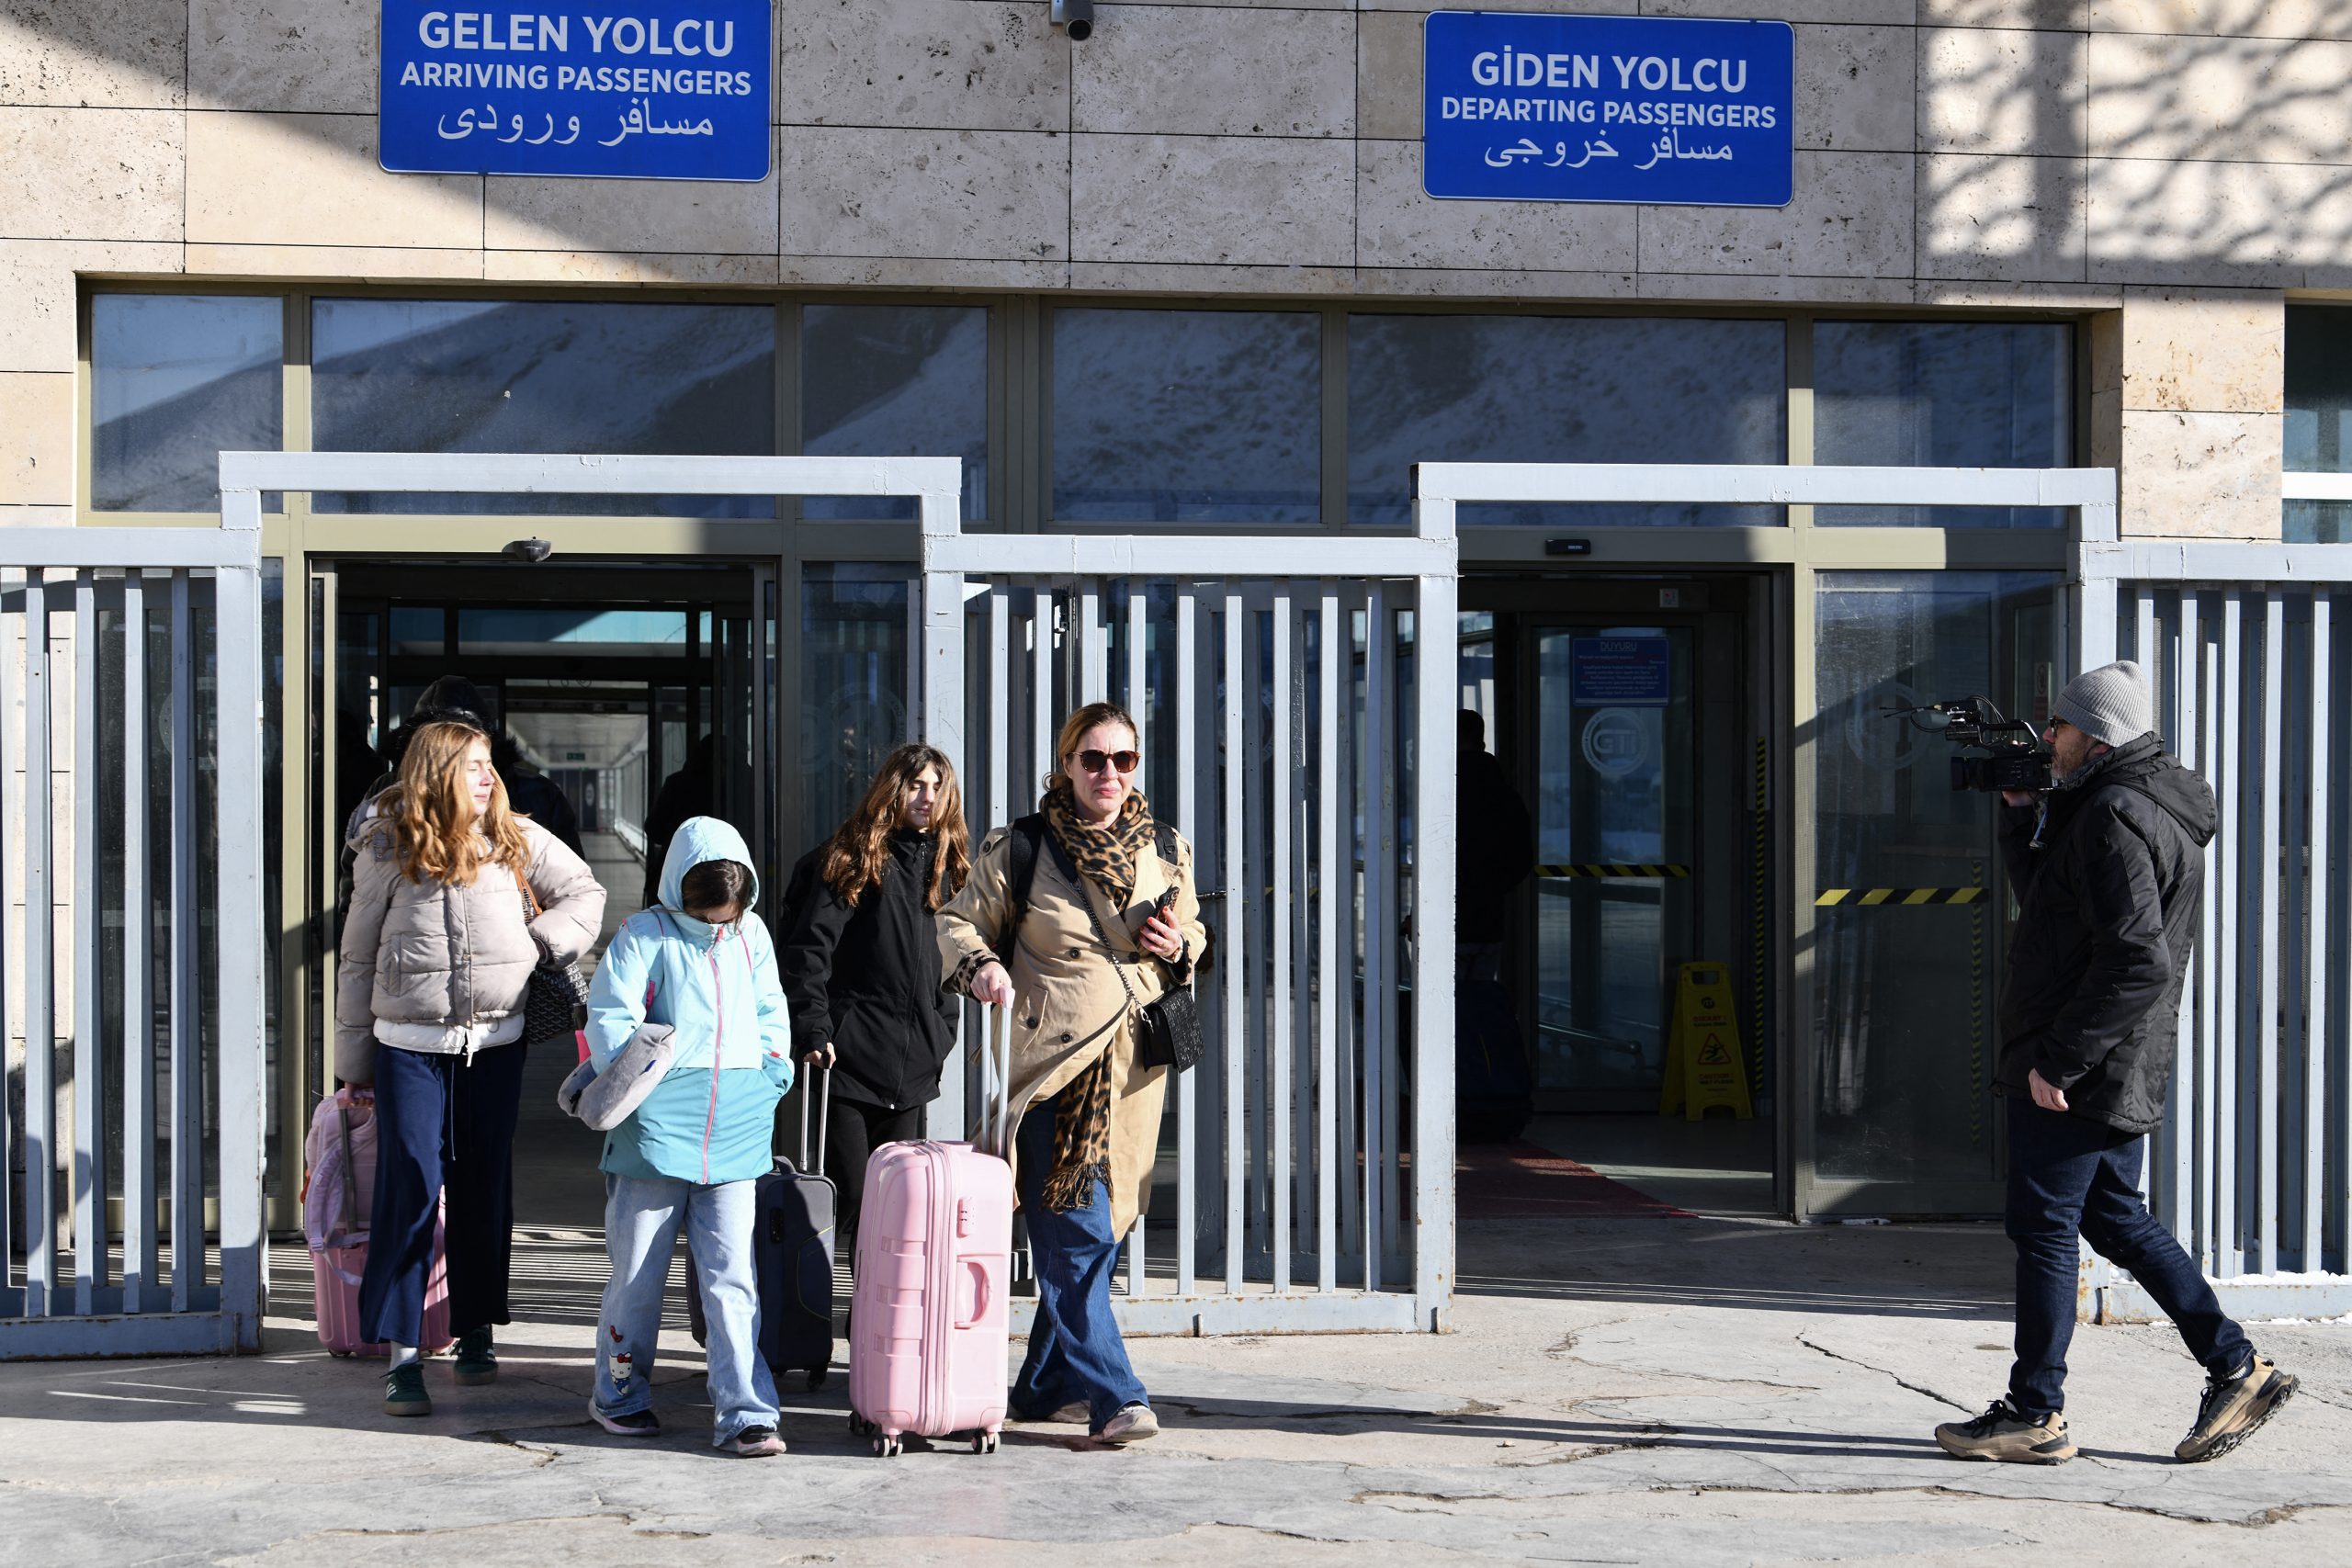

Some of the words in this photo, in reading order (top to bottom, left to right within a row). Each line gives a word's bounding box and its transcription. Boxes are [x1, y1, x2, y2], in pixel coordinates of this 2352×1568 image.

[418, 11, 568, 52] GELEN
[582, 16, 734, 57] YOLCU
[400, 61, 548, 90] ARRIVING
[558, 65, 752, 96] PASSENGERS
[1471, 44, 1599, 89] GİDEN
[1611, 55, 1747, 93] YOLCU
[597, 96, 714, 147] مسافر
[1442, 96, 1596, 123] DEPARTING
[1603, 101, 1776, 129] PASSENGERS
[1484, 129, 1619, 168] خروجی
[1634, 126, 1733, 170] مسافر
[1600, 641, 1638, 650] DUYURU
